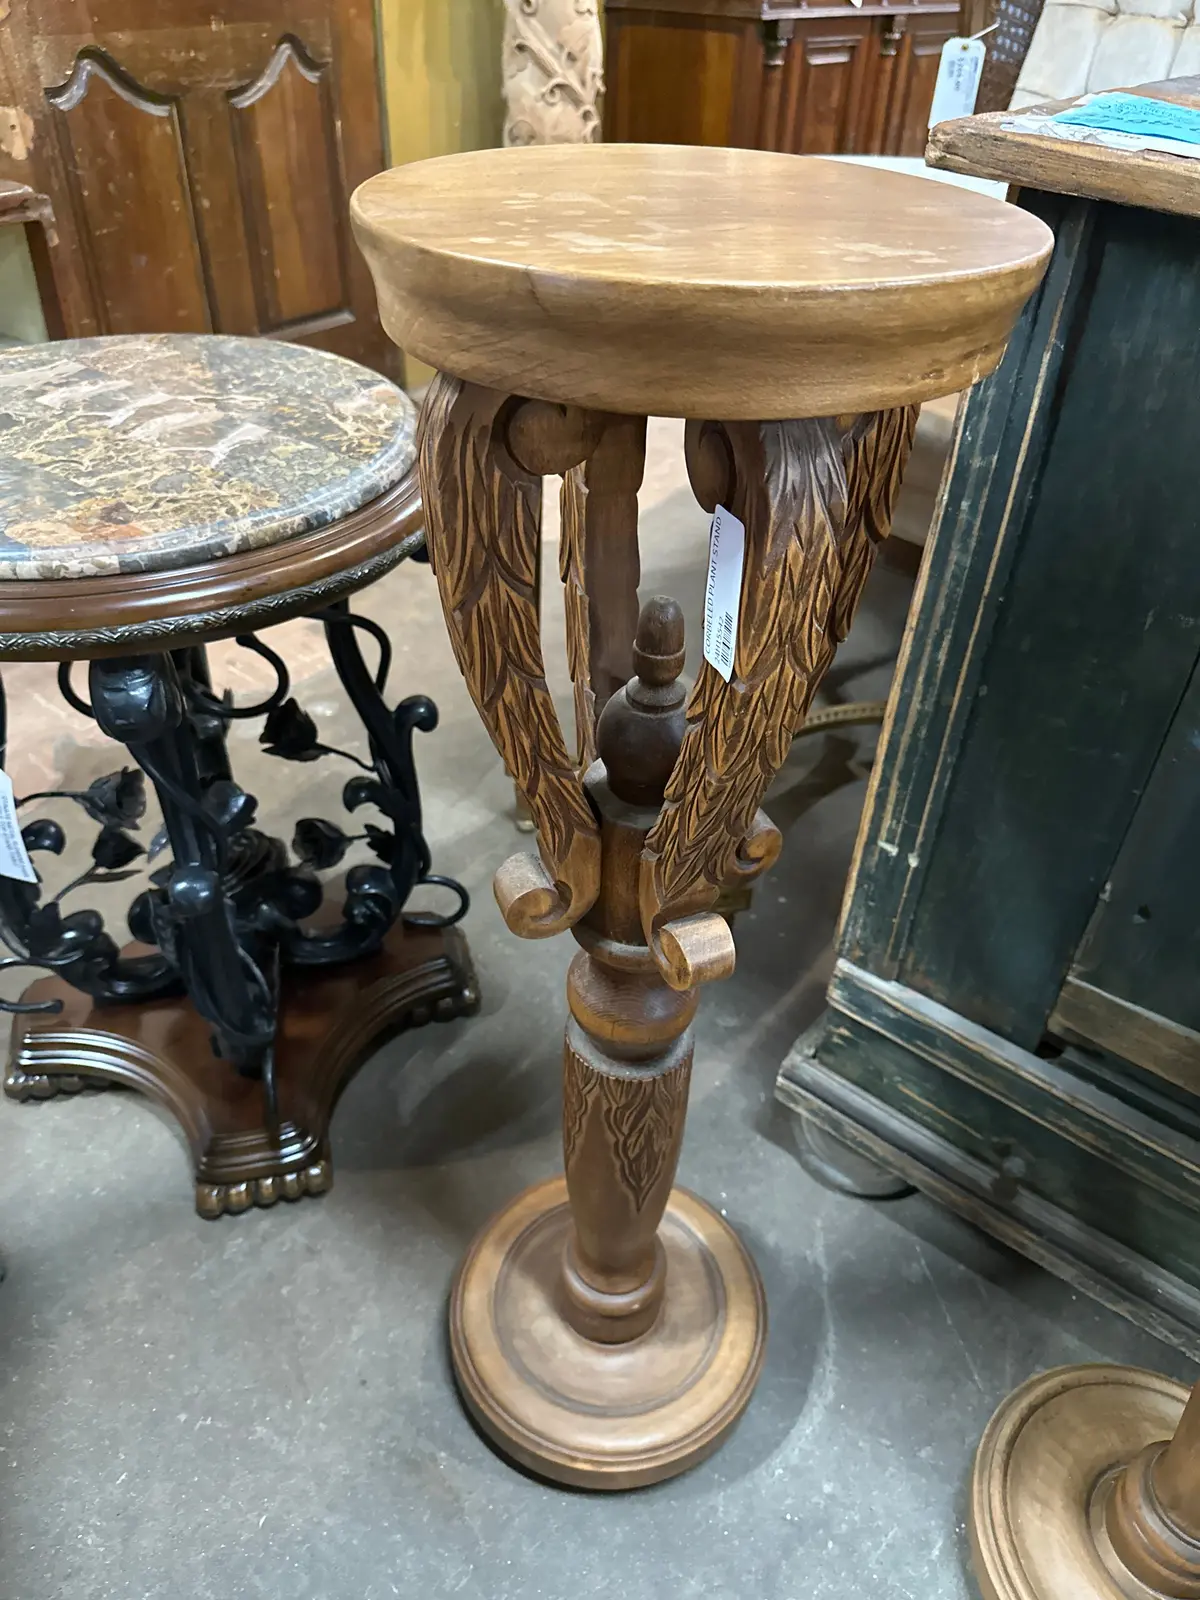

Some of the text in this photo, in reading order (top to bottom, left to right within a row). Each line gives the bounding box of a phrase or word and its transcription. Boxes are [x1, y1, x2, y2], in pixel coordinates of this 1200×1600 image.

[705, 516, 722, 654] CORBELED PLANT STAND
